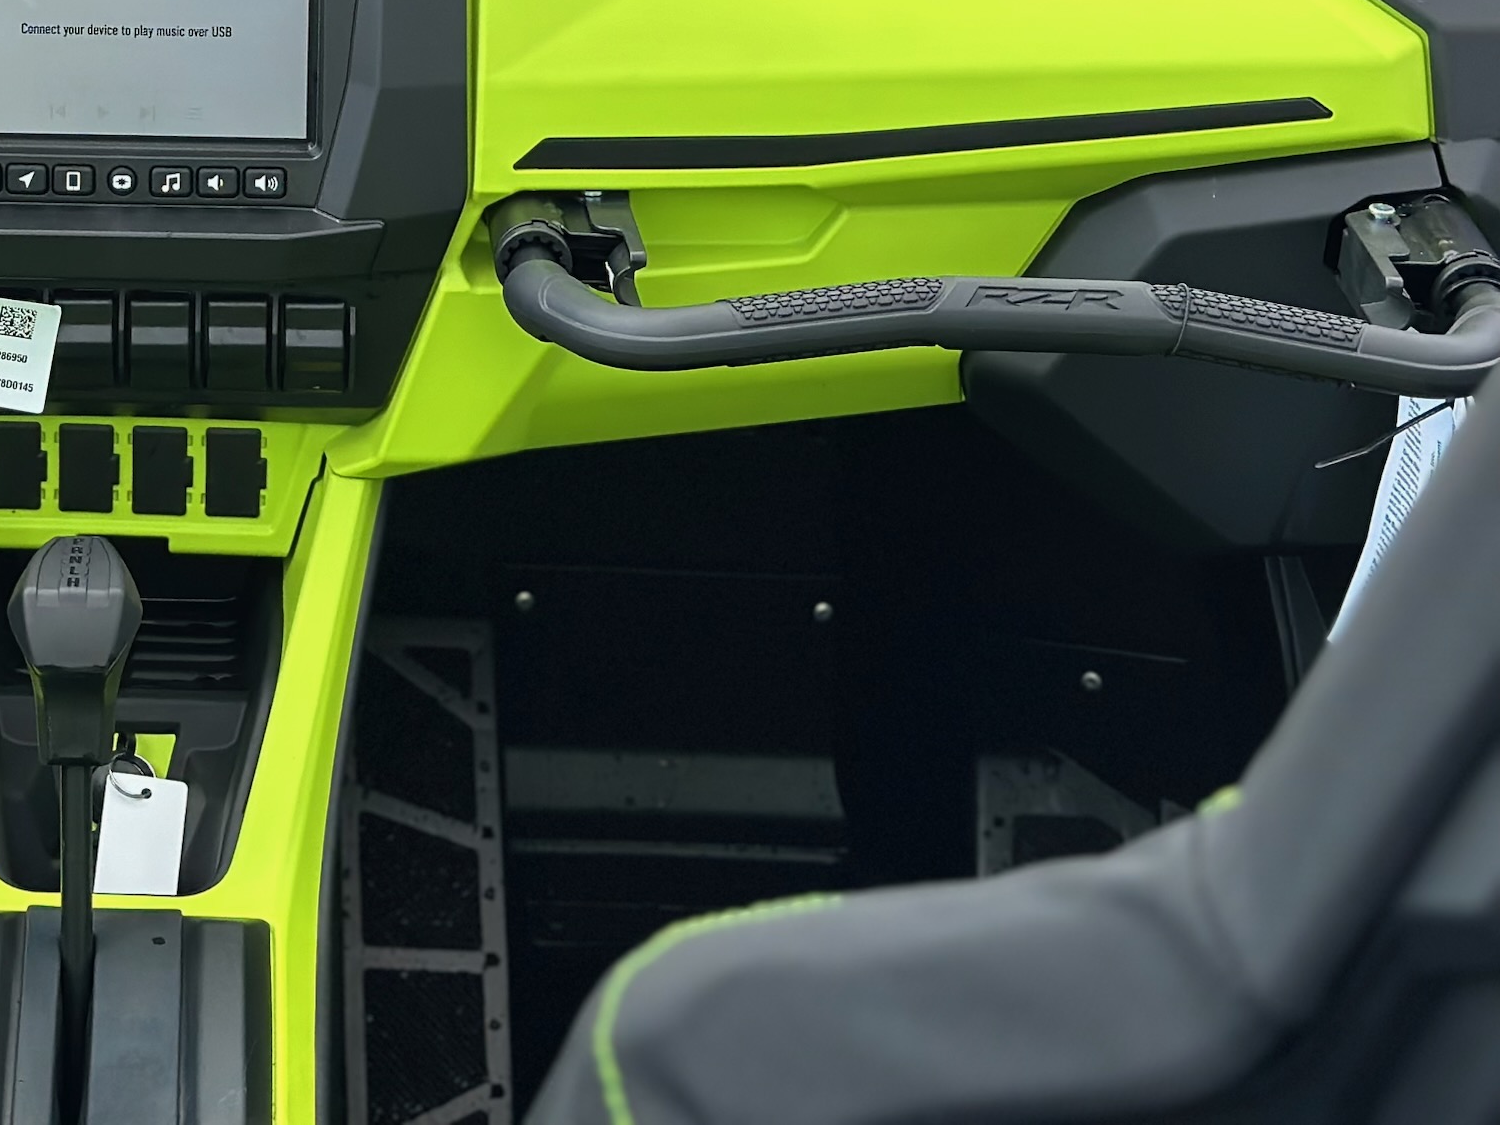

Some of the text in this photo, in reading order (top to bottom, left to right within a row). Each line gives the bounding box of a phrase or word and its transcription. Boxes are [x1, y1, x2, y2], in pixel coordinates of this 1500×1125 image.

[21, 22, 232, 40] Connect your device to play music over USB
[965, 285, 1125, 312] RZR
